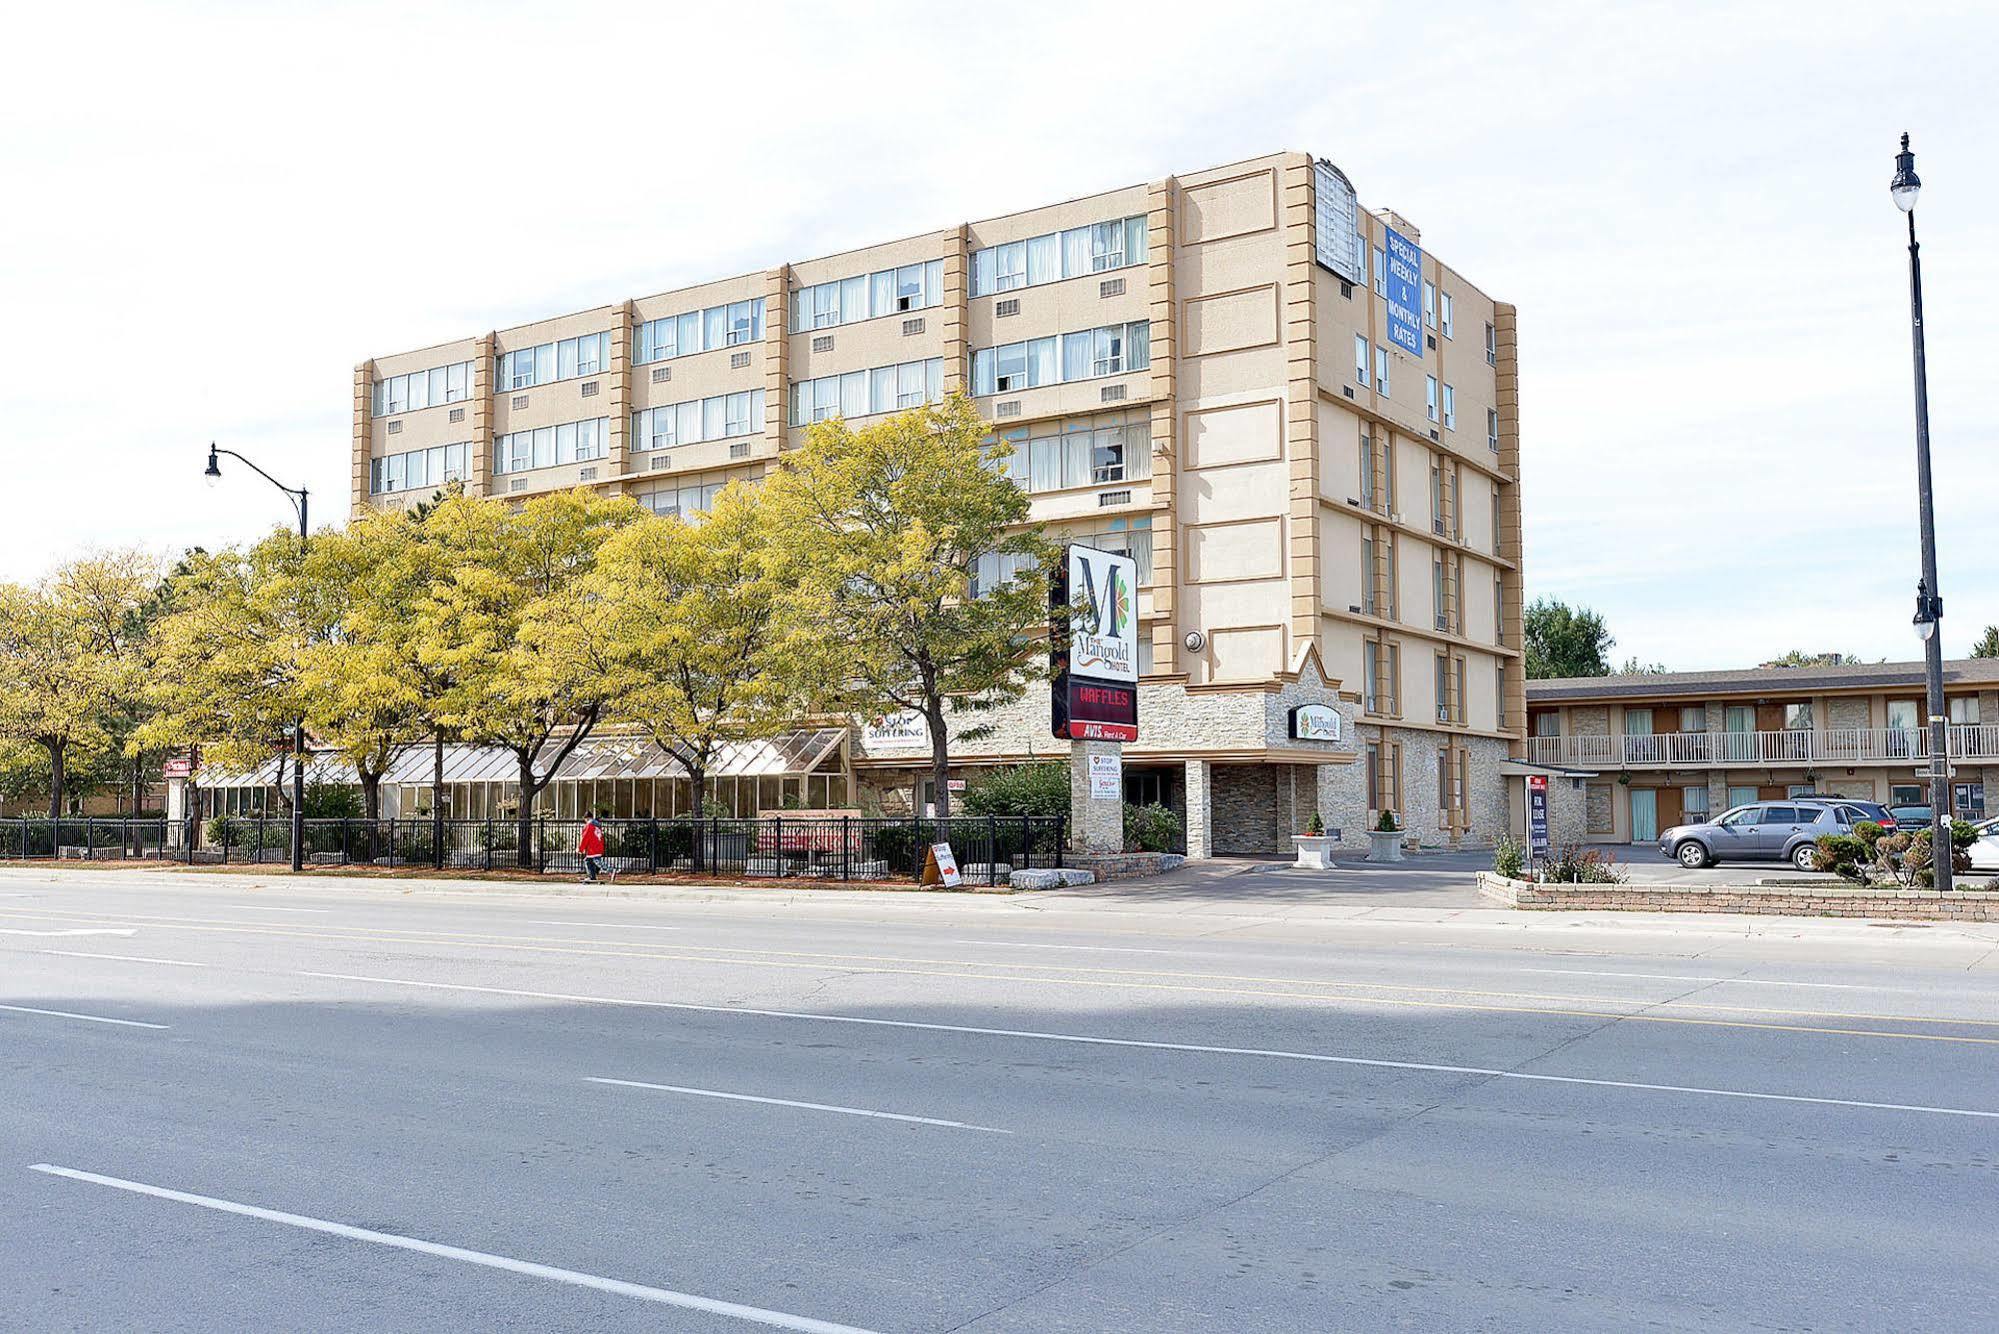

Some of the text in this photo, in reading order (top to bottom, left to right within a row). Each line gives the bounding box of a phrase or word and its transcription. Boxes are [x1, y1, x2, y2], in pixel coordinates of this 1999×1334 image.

[1389, 236, 1418, 268] SPECIAL
[1390, 256, 1418, 287] WEEKLY
[1401, 285, 1408, 302] &
[1388, 298, 1421, 331] MONTHLY
[1393, 323, 1417, 349] RATES
[1077, 556, 1122, 639] M
[1078, 635, 1129, 671] Marigold
[1111, 661, 1130, 673] HOTEL
[1079, 687, 1129, 706] WAFFLES
